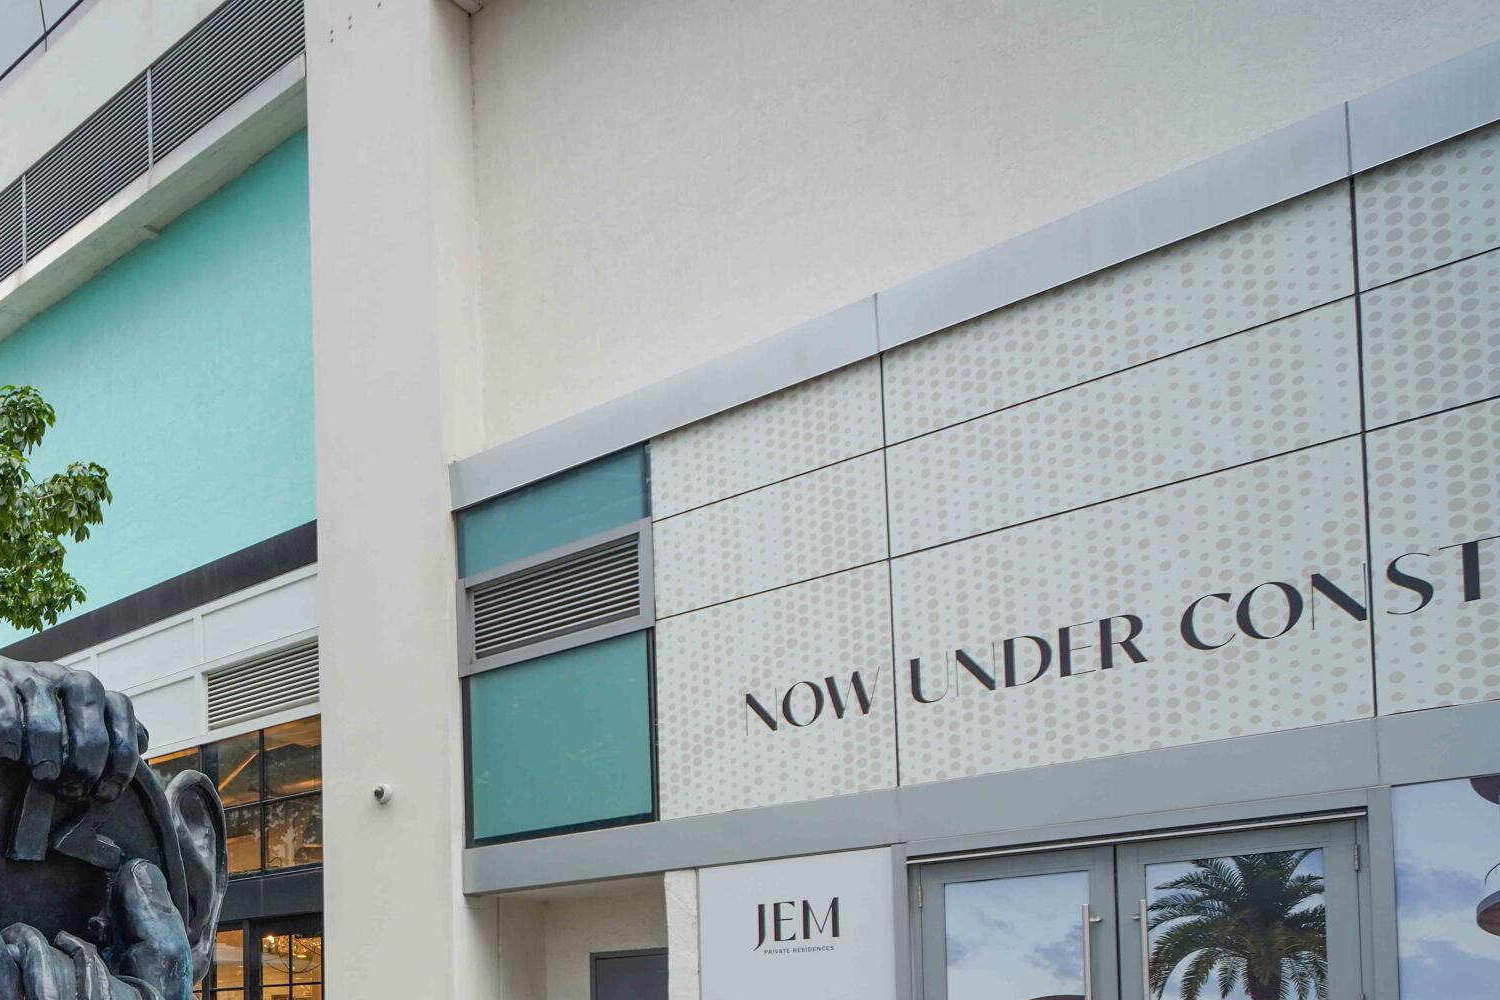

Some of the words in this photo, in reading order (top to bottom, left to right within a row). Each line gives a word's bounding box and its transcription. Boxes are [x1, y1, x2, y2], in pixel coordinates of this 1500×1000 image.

[746, 666, 881, 737] NOW
[909, 613, 1149, 705] UNDER
[753, 896, 841, 951] JEM
[792, 945, 835, 953] RESIDENCES
